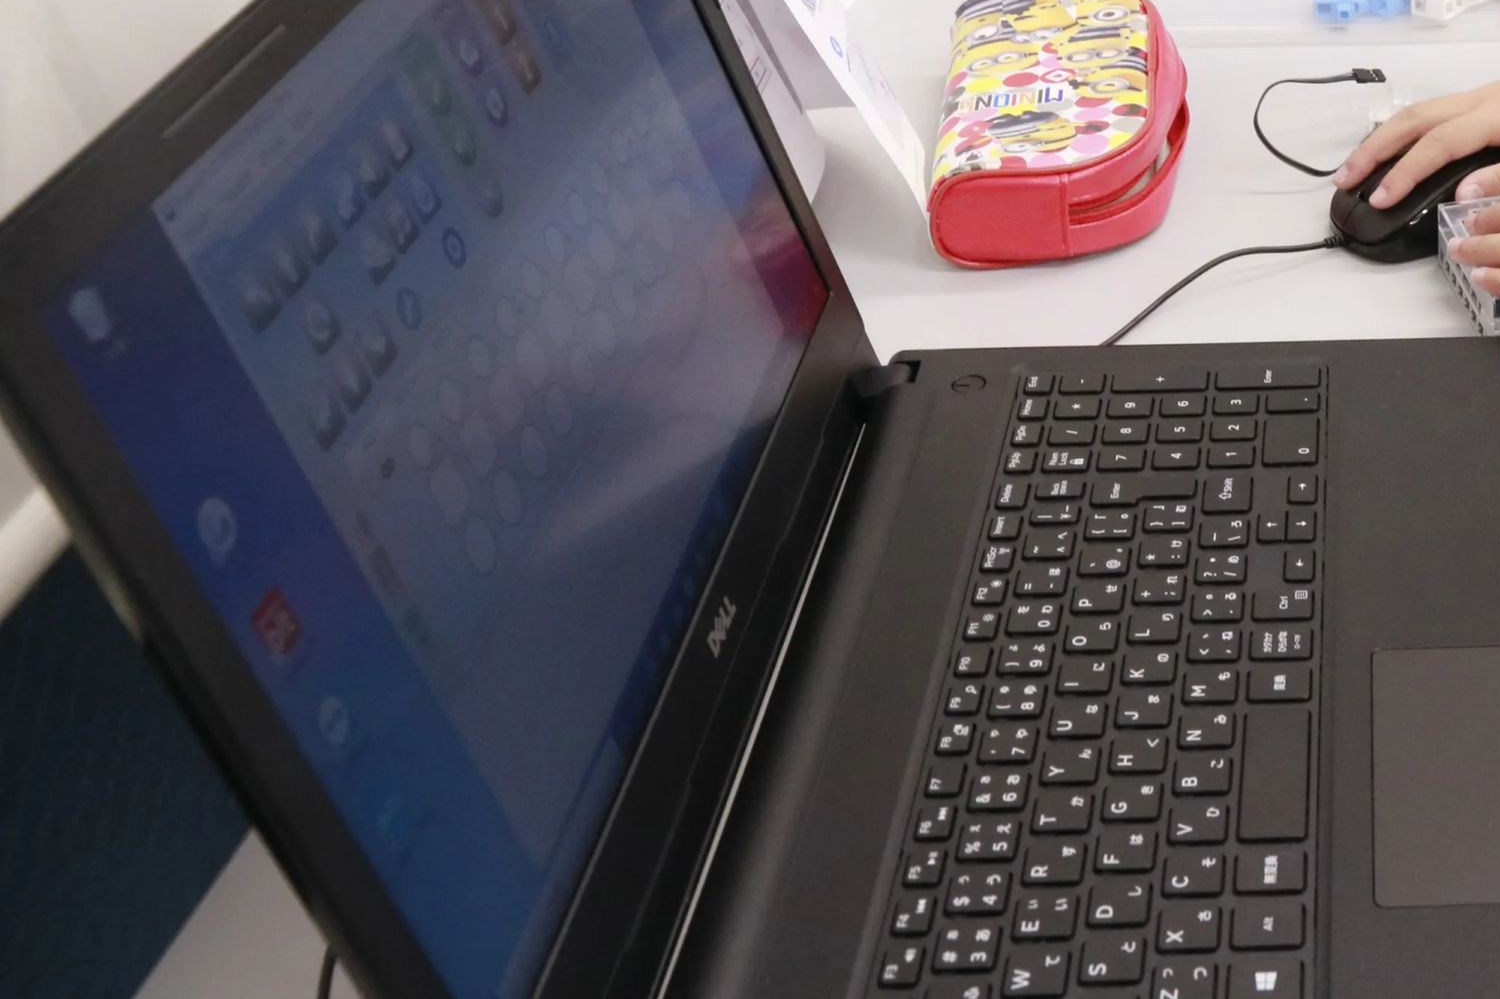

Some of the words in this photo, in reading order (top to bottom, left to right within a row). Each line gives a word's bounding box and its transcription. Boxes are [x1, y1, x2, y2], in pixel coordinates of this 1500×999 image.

[1078, 598, 1092, 607] P
[707, 595, 737, 659] DELL
[1135, 629, 1150, 637] L
[1072, 635, 1087, 646] O
[1029, 659, 1043, 668] 9
[1129, 669, 1144, 678] K
[1191, 685, 1206, 697] M
[1020, 701, 1035, 710] 8
[1124, 711, 1139, 720] J
[1056, 720, 1073, 731] U
[1186, 730, 1202, 741] N
[1011, 747, 1025, 755] 7
[1117, 754, 1133, 766] H
[1048, 765, 1065, 777] Y
[929, 778, 941, 790] F7
[1181, 776, 1198, 787] B
[1002, 792, 1017, 802] 6
[1111, 802, 1127, 814] G
[1039, 814, 1056, 826] T
[919, 821, 932, 834] F6
[1176, 823, 1193, 836] V
[992, 841, 1008, 851] 5
[1103, 854, 1120, 864] F
[908, 866, 922, 879] F5
[1030, 865, 1048, 878] R
[1171, 876, 1189, 888] C
[982, 894, 998, 905] 4
[1095, 905, 1113, 919] D
[896, 914, 910, 928] F4
[1021, 920, 1040, 932] E
[1165, 930, 1184, 943] X
[970, 951, 987, 962] 3
[883, 964, 898, 979] F3
[1088, 963, 1107, 976] S
[1010, 969, 1031, 990] W
